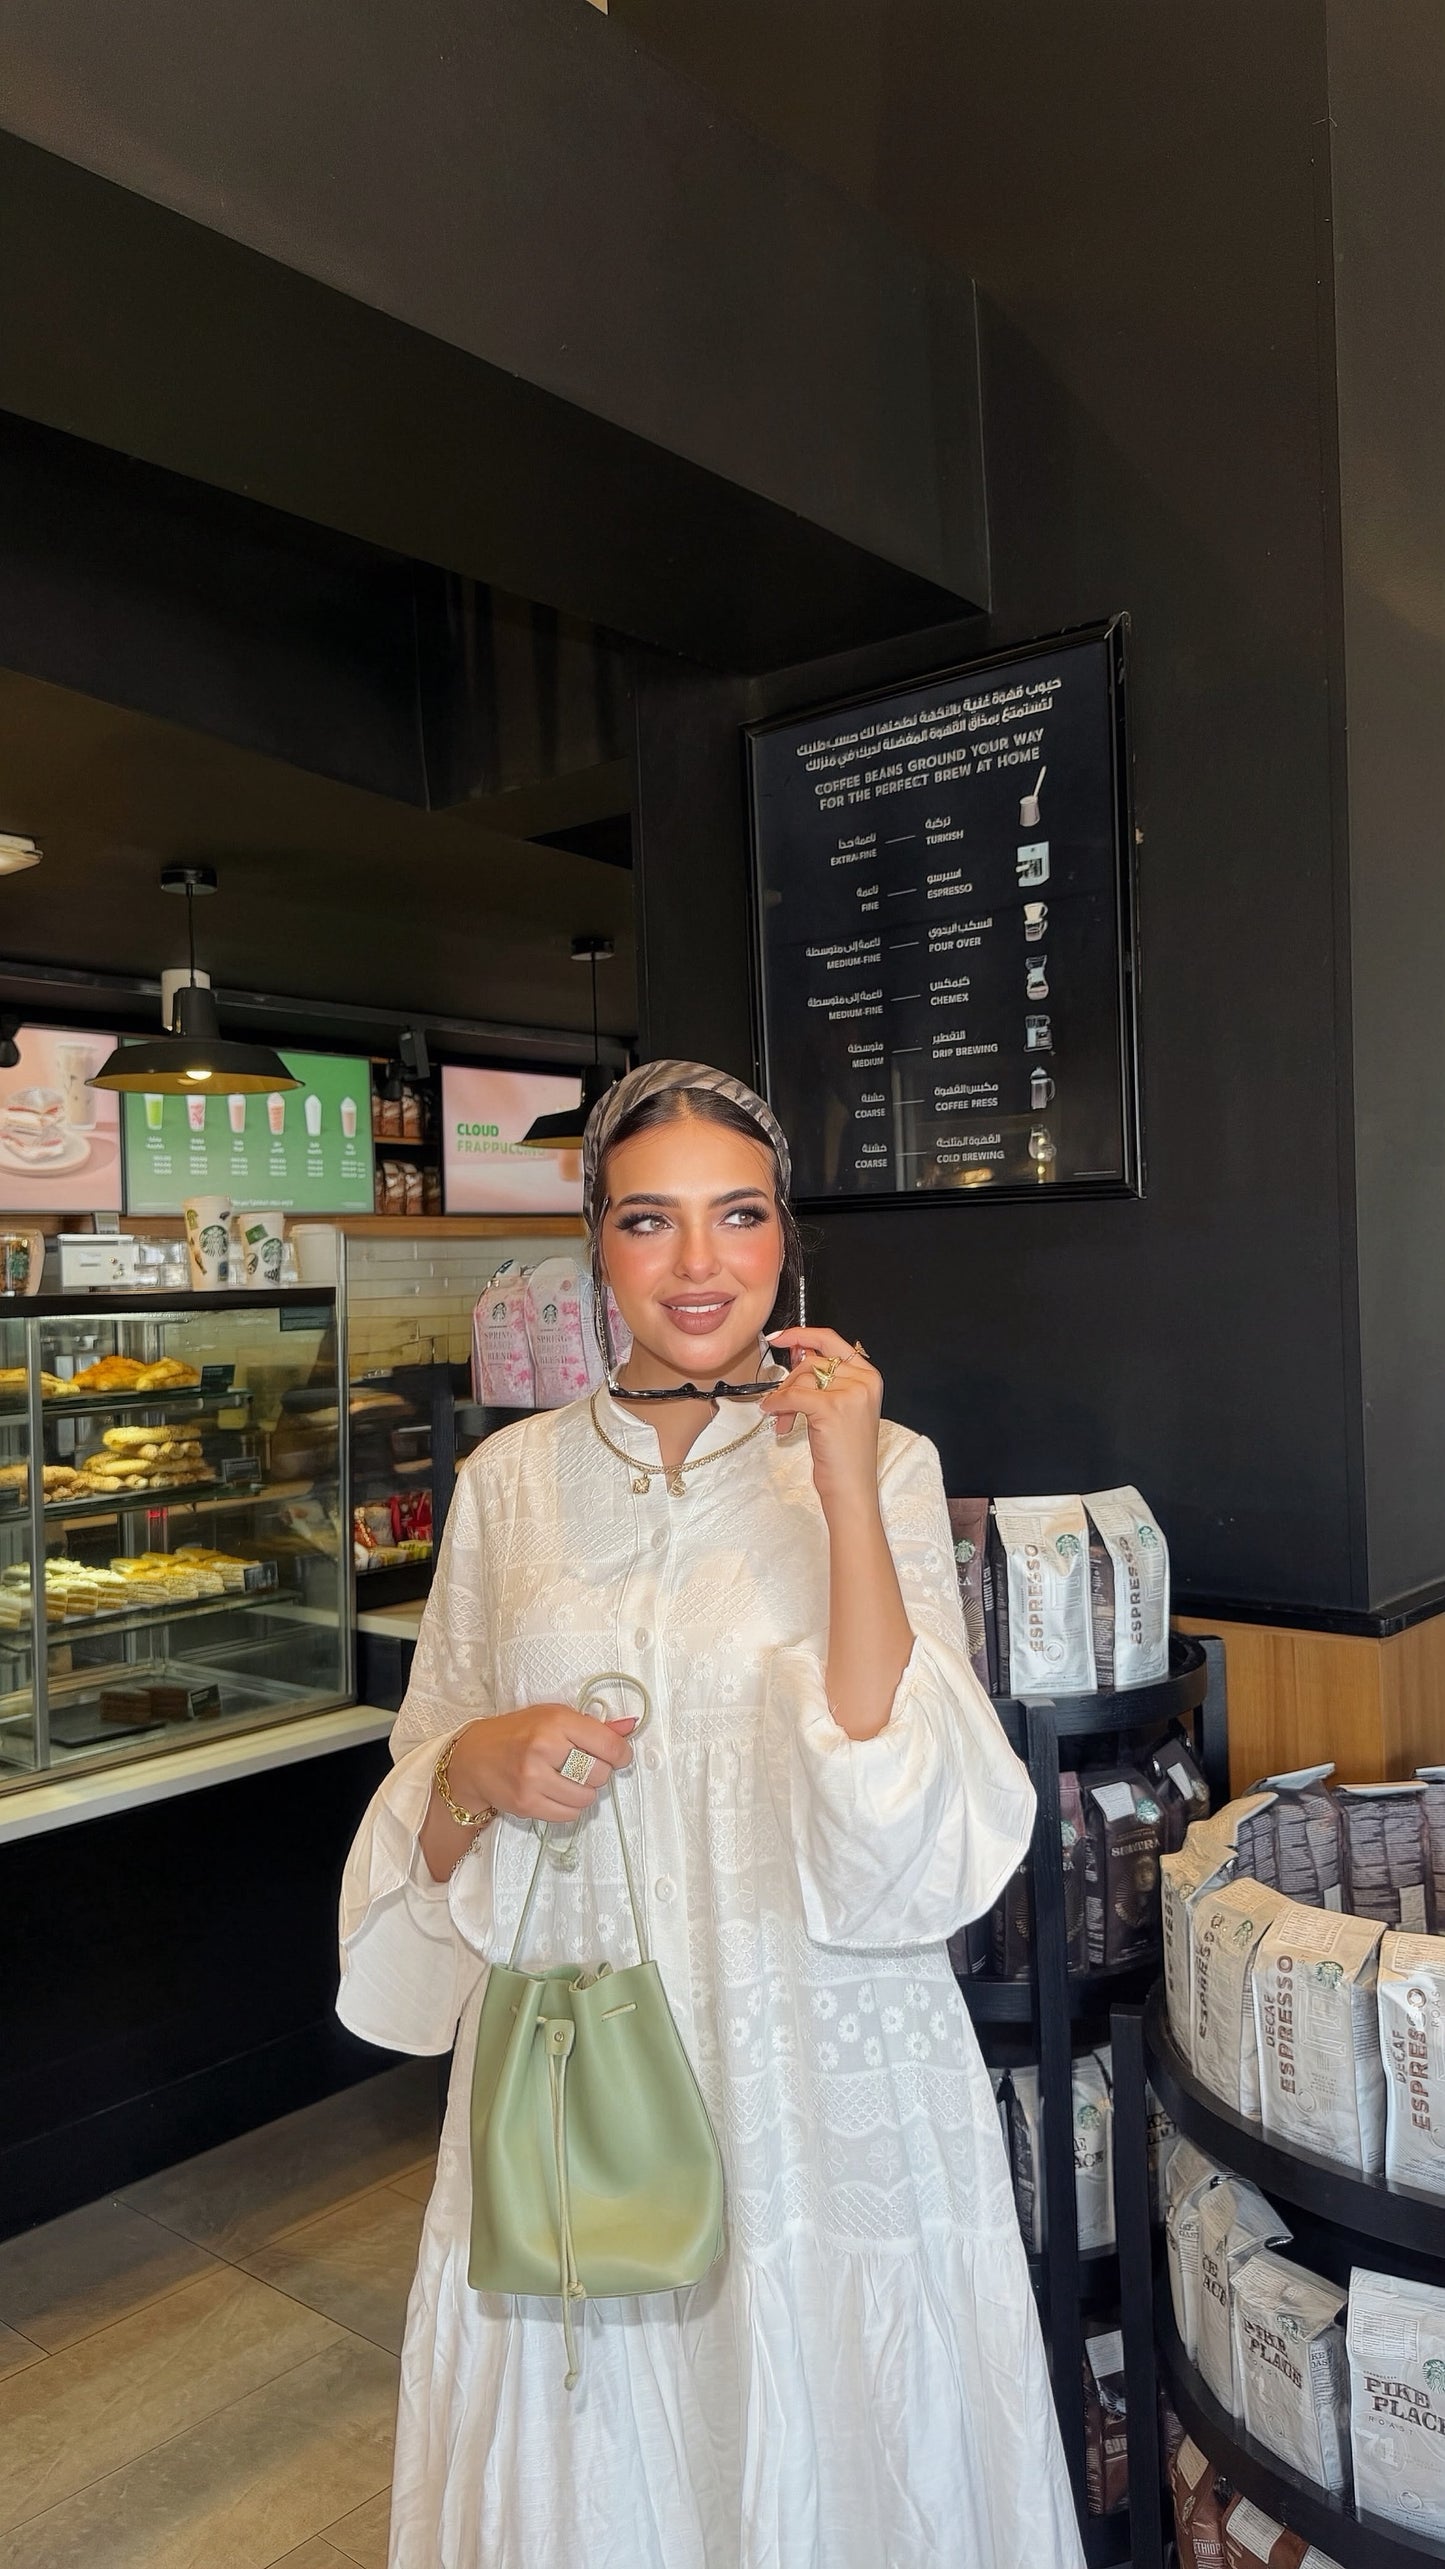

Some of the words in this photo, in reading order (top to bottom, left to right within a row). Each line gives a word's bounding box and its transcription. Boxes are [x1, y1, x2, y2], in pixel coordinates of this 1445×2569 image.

[991, 685, 1024, 706] قهوة
[1025, 678, 1062, 698] حبوب
[962, 694, 991, 714] غنية
[1001, 697, 1053, 722] لتستمتع
[918, 703, 962, 724] بالنكهة
[968, 713, 1000, 731] بمذاق
[860, 725, 875, 740] لك
[929, 719, 966, 740] القهوة
[796, 739, 826, 757] طلبك
[827, 733, 858, 751] حسب
[882, 730, 928, 750] المفضلة
[837, 750, 856, 768] في
[856, 741, 881, 759] لديك
[805, 756, 837, 771] منزلك
[814, 774, 861, 796] COFFEE
[864, 763, 904, 785] BEANS
[907, 749, 966, 772] GROUND
[970, 737, 1009, 757] YOUR
[1013, 728, 1044, 747] WAY
[820, 795, 845, 811] FOR
[848, 788, 871, 804] THE
[875, 773, 930, 797] PERFECT
[934, 763, 972, 781] BREW
[976, 758, 992, 774] AT
[997, 746, 1040, 769] HOME
[926, 829, 964, 845] TURKISH
[830, 848, 877, 867] EXTRA-FINE
[927, 883, 973, 899] ESPRESSO
[861, 901, 880, 913] FINE
[928, 941, 954, 953] POUR
[956, 936, 981, 949] OVER
[826, 953, 882, 970] MEDIUM-FINE
[930, 992, 969, 1006] CHEMEX
[828, 1005, 883, 1021] MEDIUM-FINE
[932, 1048, 953, 1059] DRIP
[955, 1043, 998, 1057] BREWING
[852, 1057, 884, 1068] MEDIUM
[935, 1100, 969, 1111] COFFEE
[971, 1097, 998, 1108] PRESS
[855, 1108, 886, 1119] COARSE
[457, 1123, 500, 1137] CLOUD
[855, 1159, 888, 1169] COARSE
[936, 1153, 960, 1164] COLD
[962, 1150, 1005, 1162] BREWING
[1025, 1543, 1045, 1653] ESPRESSO
[1119, 1536, 1143, 1646] ESPRESSO
[1264, 1993, 1275, 2049] DECAF
[1276, 1955, 1296, 2095] ESPRESSO
[1392, 2029, 1407, 2084] DECAF
[1248, 2335, 1303, 2390] PLACE
[1363, 2376, 1430, 2409] PIKE
